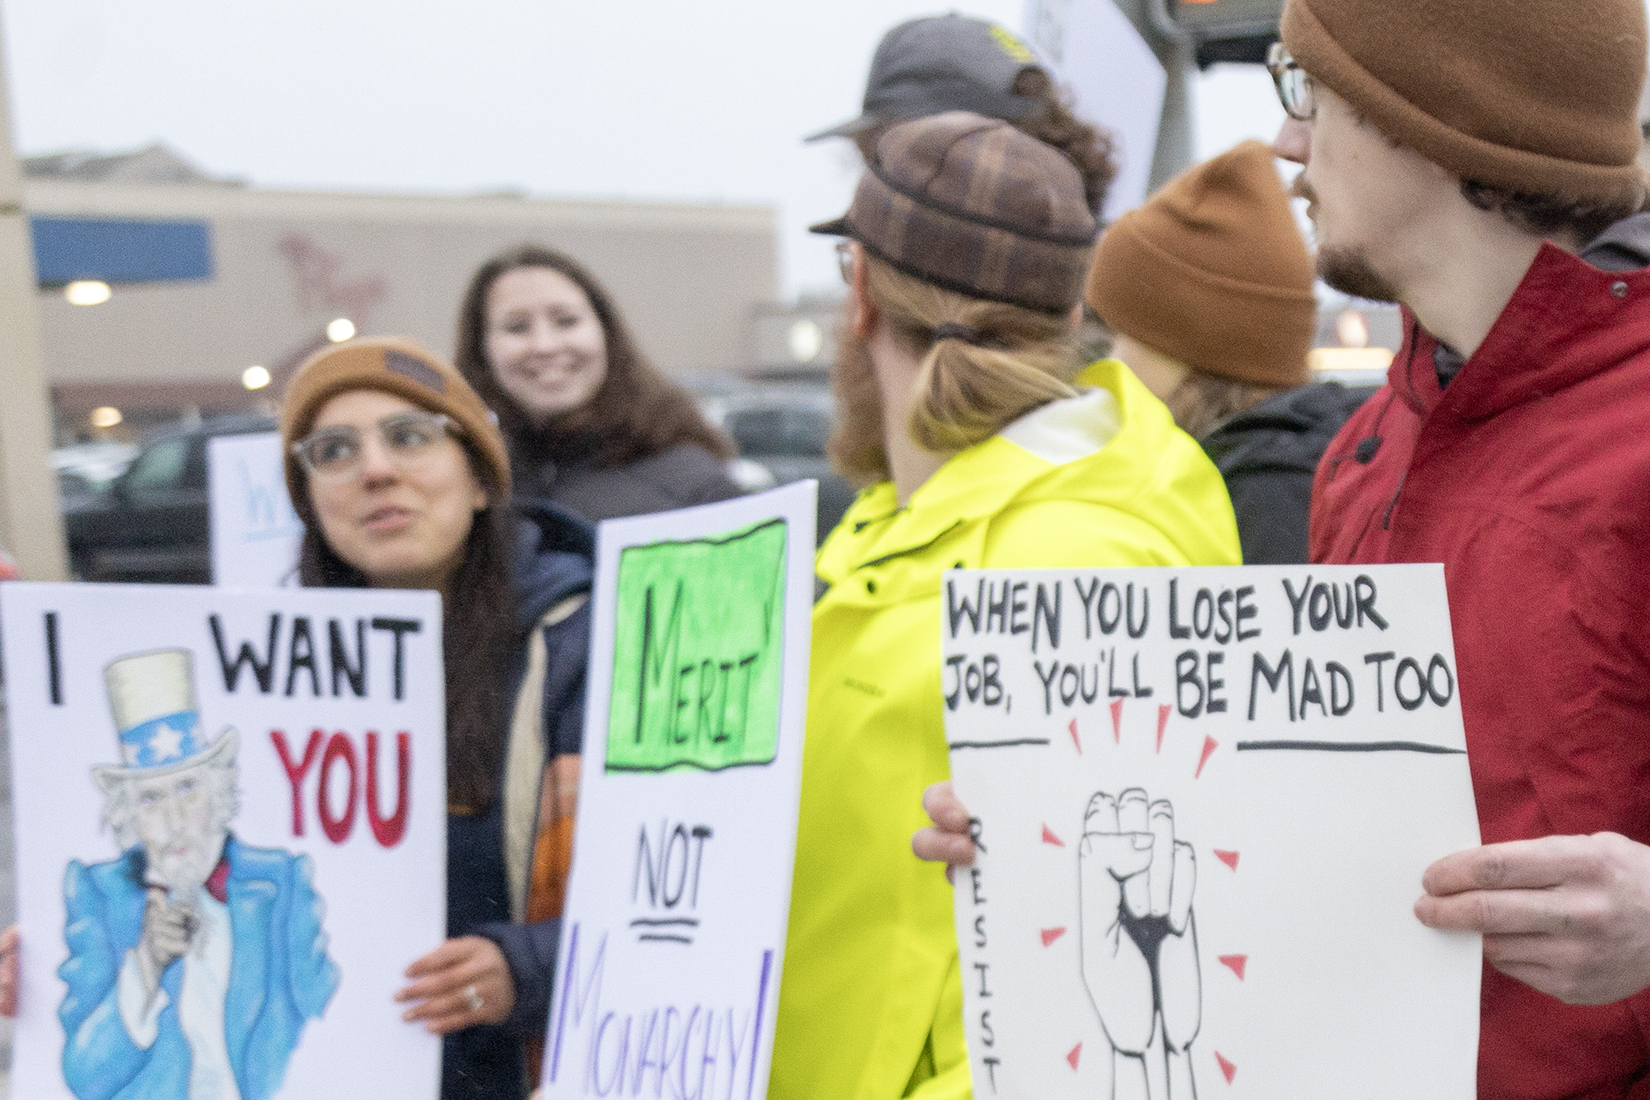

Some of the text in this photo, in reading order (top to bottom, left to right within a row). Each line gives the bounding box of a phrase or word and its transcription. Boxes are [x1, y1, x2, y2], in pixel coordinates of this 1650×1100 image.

[43, 611, 422, 705] I WANT
[947, 574, 1390, 654] WHEN YOU LOSE YOUR
[634, 581, 761, 746] MERIT
[944, 646, 1454, 722] JOB, YOU'LL BE MAD TOO
[270, 728, 412, 849] YOU
[631, 818, 714, 911] NOT
[967, 816, 1001, 1096] RESIST
